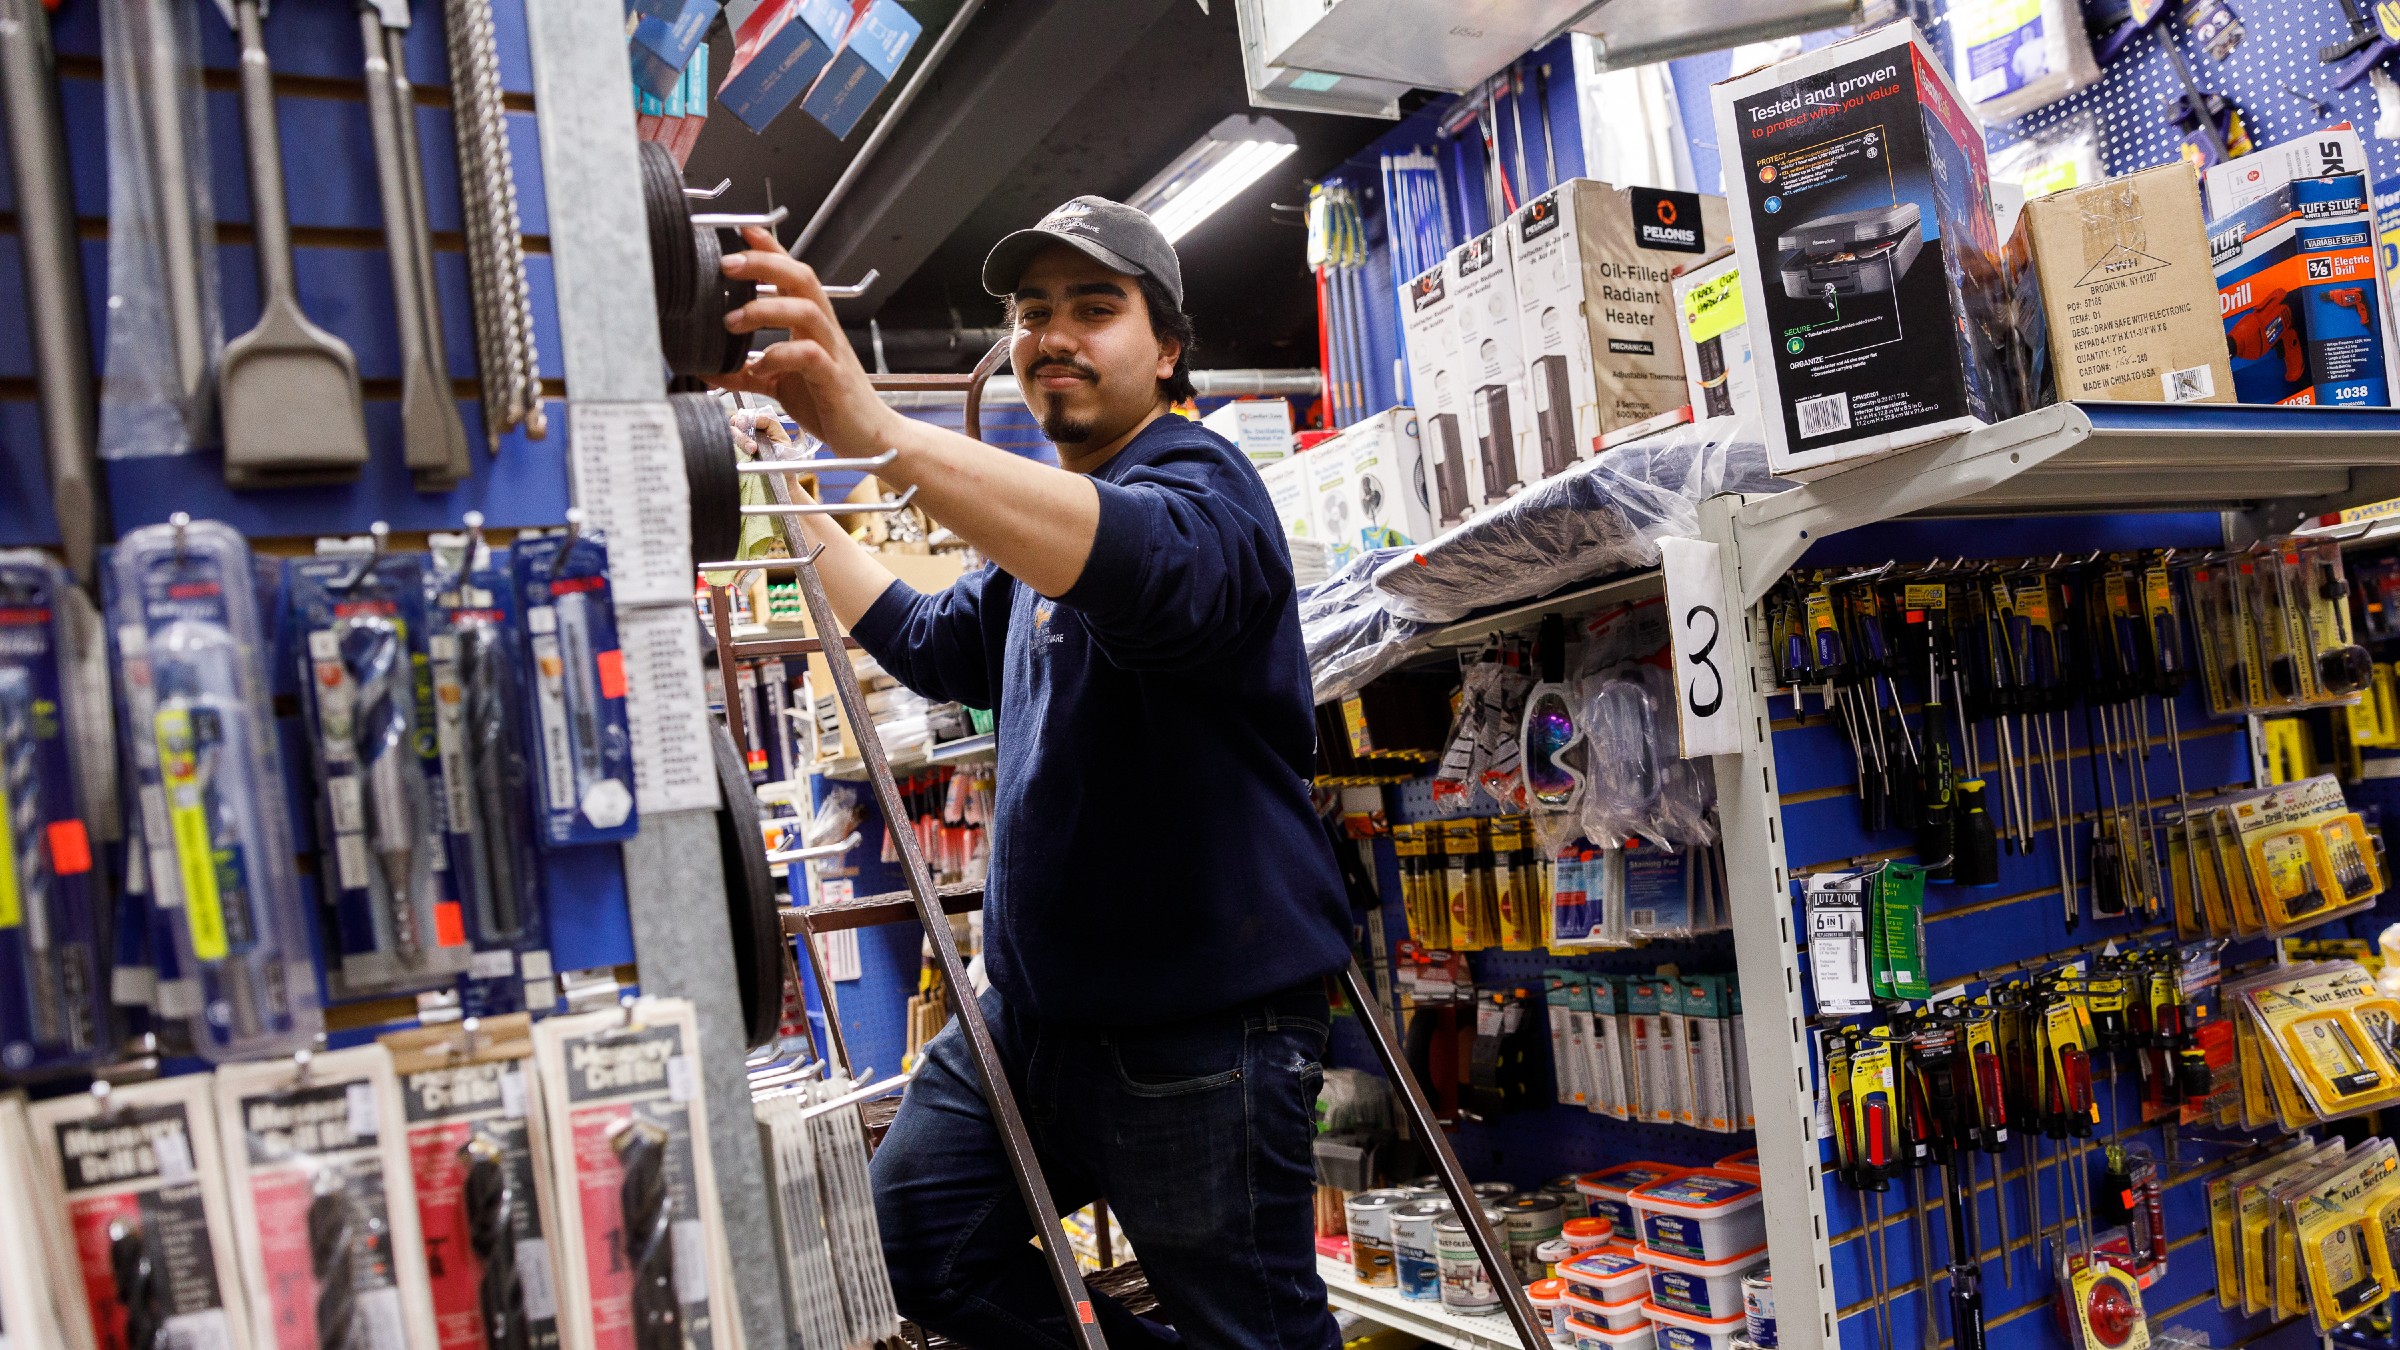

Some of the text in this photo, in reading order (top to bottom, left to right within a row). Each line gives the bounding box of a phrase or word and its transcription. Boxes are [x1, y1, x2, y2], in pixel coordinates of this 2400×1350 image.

[1749, 66, 1896, 122] Tested and proven
[1752, 84, 1900, 138] to protect what you value
[1757, 152, 1787, 167] PROTECT
[2300, 198, 2361, 214] TUFF STUFF
[1643, 225, 1696, 242] PELONIS
[2211, 222, 2246, 254] TUFF
[2308, 235, 2363, 248] VARIABLE SPEED
[2334, 255, 2370, 266] Electric
[1601, 263, 1669, 283] Oil-Filled
[2335, 264, 2355, 276] Drill
[2090, 272, 2157, 295] BROOKLYN, NY 11207
[1603, 286, 1660, 304] Radiant
[2219, 283, 2251, 315] Drill
[1606, 308, 1654, 325] Heater
[2094, 321, 2114, 333] DRAW
[2115, 316, 2131, 328] SAFE
[2132, 312, 2149, 324] WITH
[2150, 303, 2191, 320] ELECTRONIC
[1784, 325, 1811, 337] SECURE
[1610, 342, 1653, 352] MECHANICAL
[2074, 338, 2100, 351] KEYPAD
[1790, 356, 1824, 370] ORGANIZE
[2076, 350, 2111, 364] QUANTITY:
[2118, 345, 2127, 354] PC
[1612, 371, 1648, 379] Adjustable
[2083, 368, 2156, 392] MADE IN CHINA TO USA
[2335, 386, 2368, 400] 1038
[1687, 605, 1723, 717] 3
[2265, 811, 2282, 823] Drill
[2285, 812, 2299, 823] Tap
[1629, 859, 1679, 869] Staining Pad
[1815, 893, 1859, 906] LUTZ TOOL
[1817, 914, 1843, 929] 6 IN 1
[2309, 985, 2376, 1004] Nut Sett
[585, 1059, 664, 1091] Drill Bit
[251, 1098, 348, 1132] Masonr
[2341, 1185, 2360, 1202] Nut
[1670, 1221, 1684, 1230] Filler
